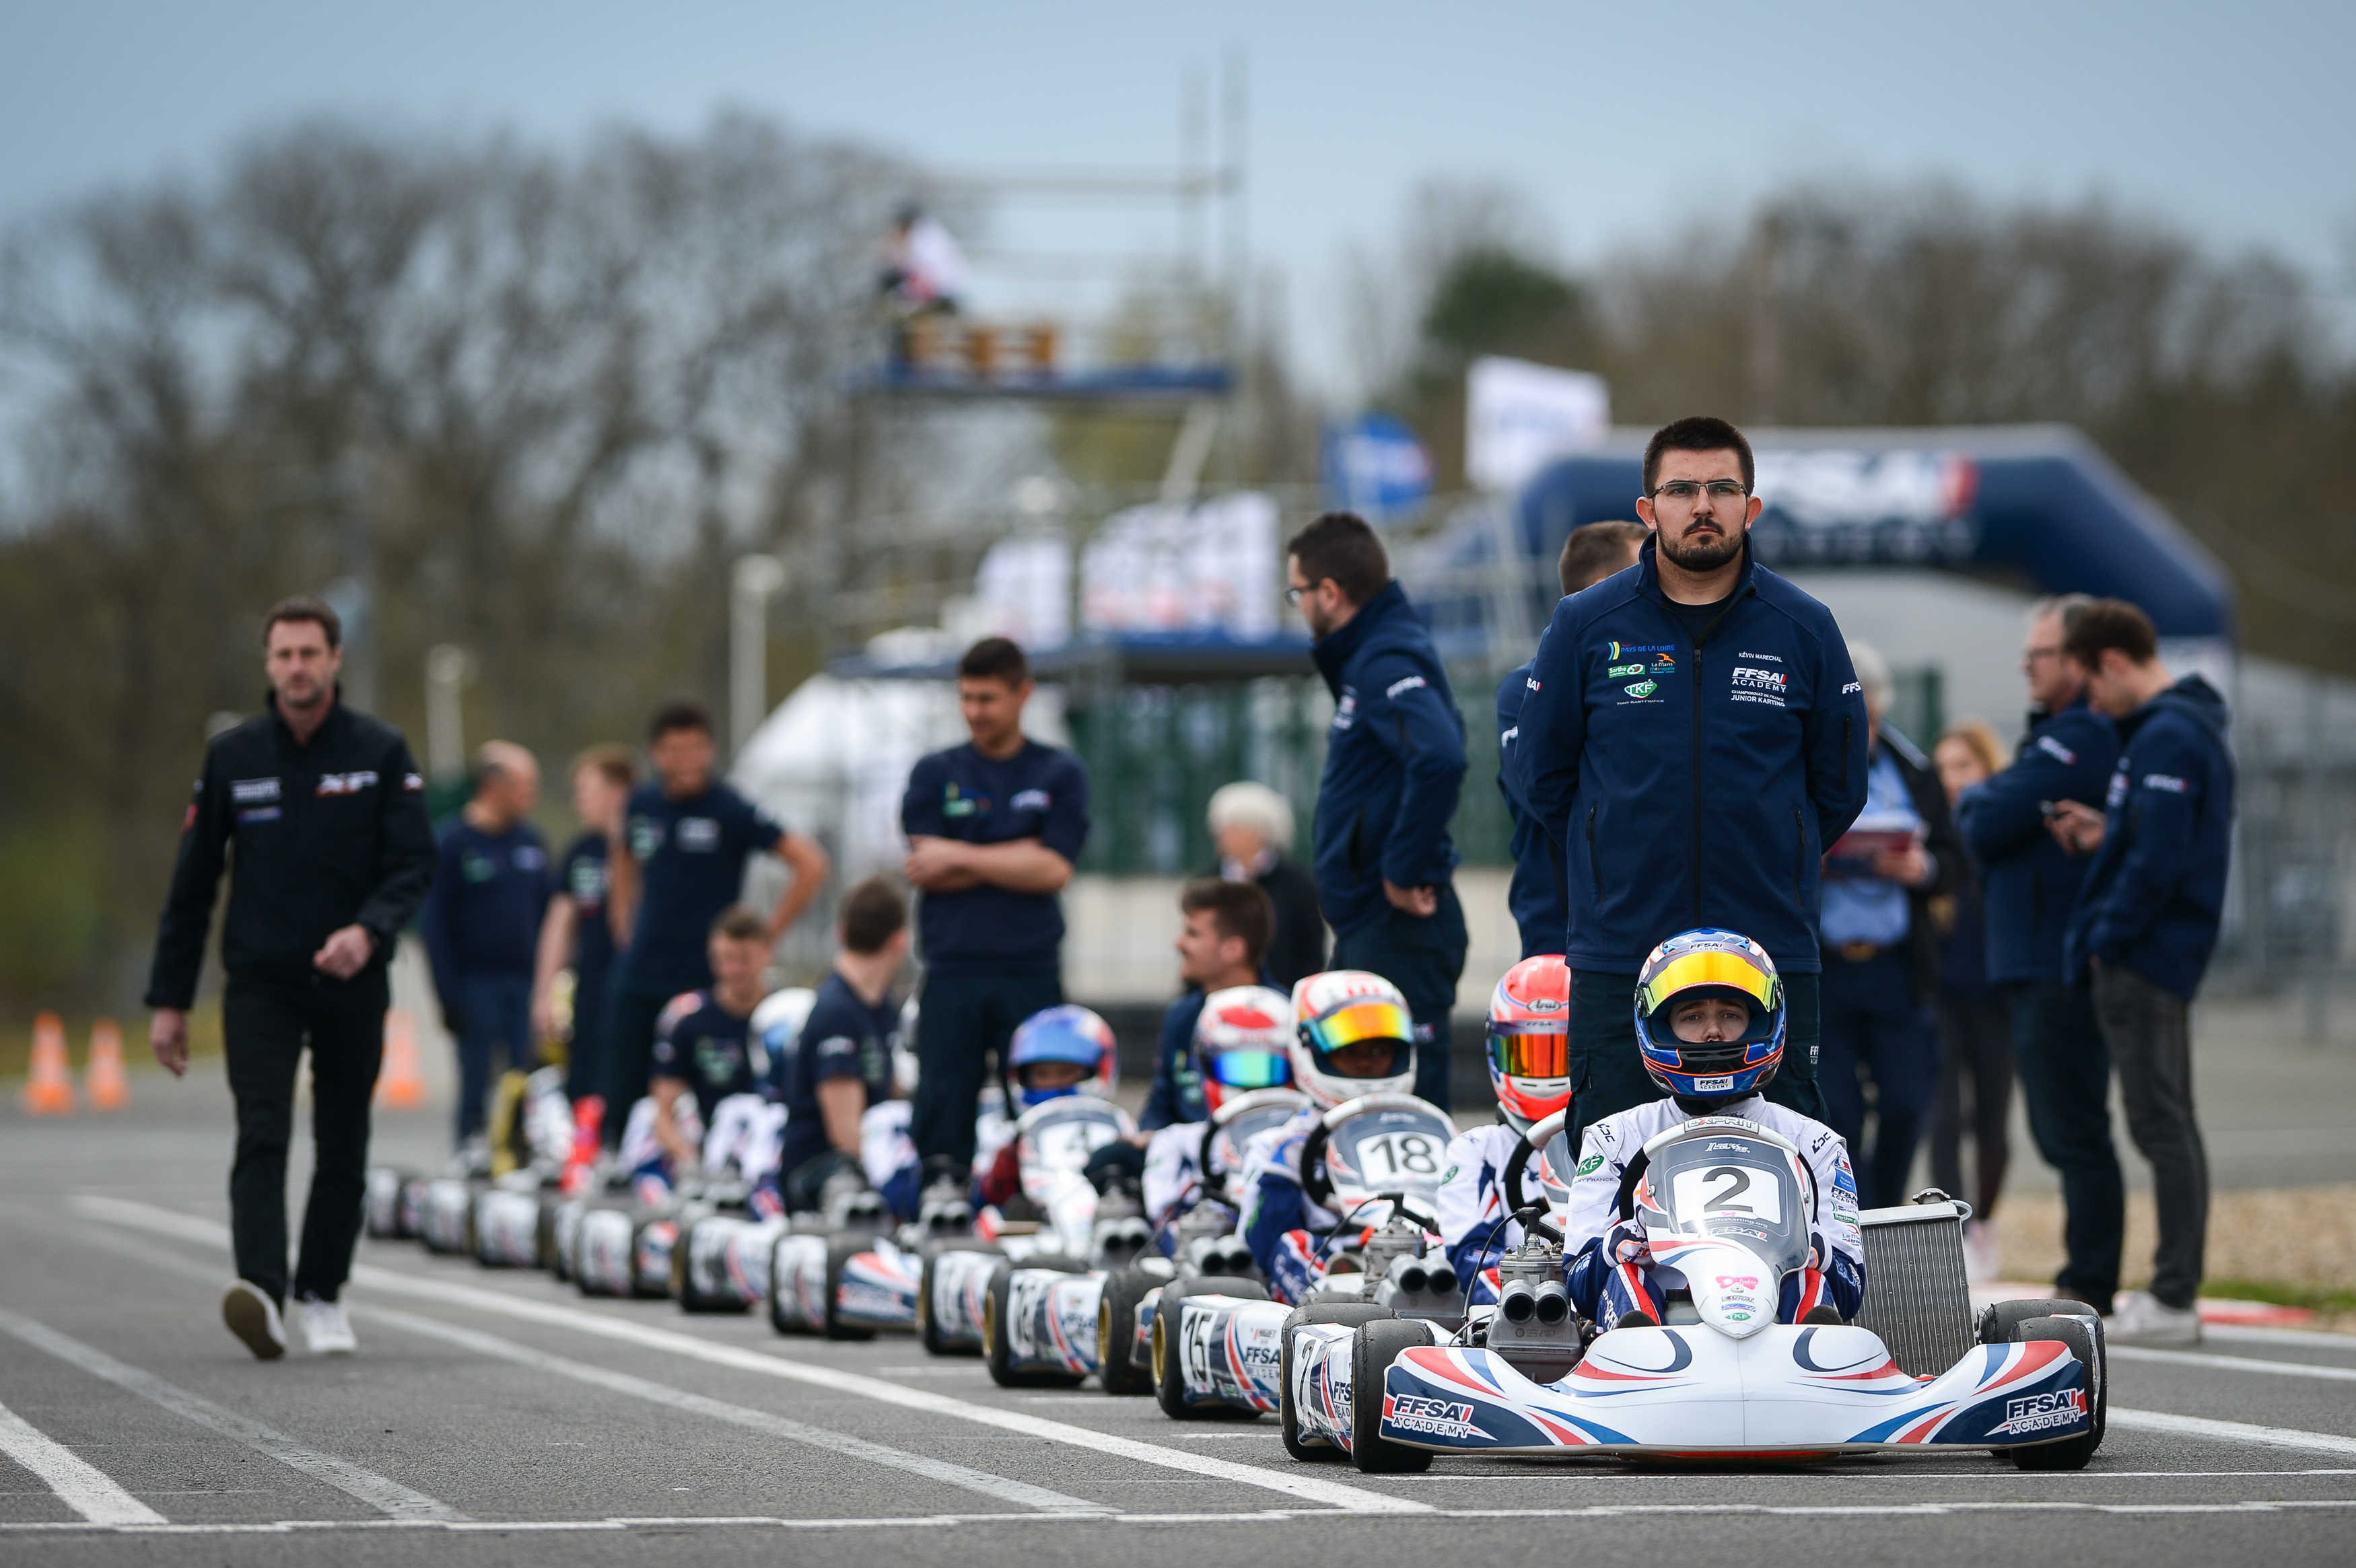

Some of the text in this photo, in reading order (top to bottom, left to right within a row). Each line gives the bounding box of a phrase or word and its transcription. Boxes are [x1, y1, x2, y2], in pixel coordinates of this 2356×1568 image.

[1739, 651, 1782, 663] KÉVIN MARECHAL
[1732, 667, 1787, 684] FFSA
[1628, 684, 1653, 694] TKF
[1732, 678, 1787, 693] ACADEMY
[1842, 681, 1862, 694] FFS
[1731, 694, 1786, 707] JUNIOR KARTING
[1688, 1117, 1756, 1129] EXPRIT
[1369, 1133, 1437, 1174] 18
[1702, 1166, 1754, 1213] 2
[1703, 1217, 1768, 1229] ww.ffsakarting.org
[1185, 1311, 1212, 1382] 15
[1245, 1346, 1280, 1364] FFSA
[1333, 1380, 1352, 1402] FFS
[1394, 1396, 1471, 1422] FFSA
[2008, 1390, 2077, 1419] FFSA
[1393, 1417, 1469, 1437] ACADEMY
[2010, 1411, 2079, 1433] ACADEMY
